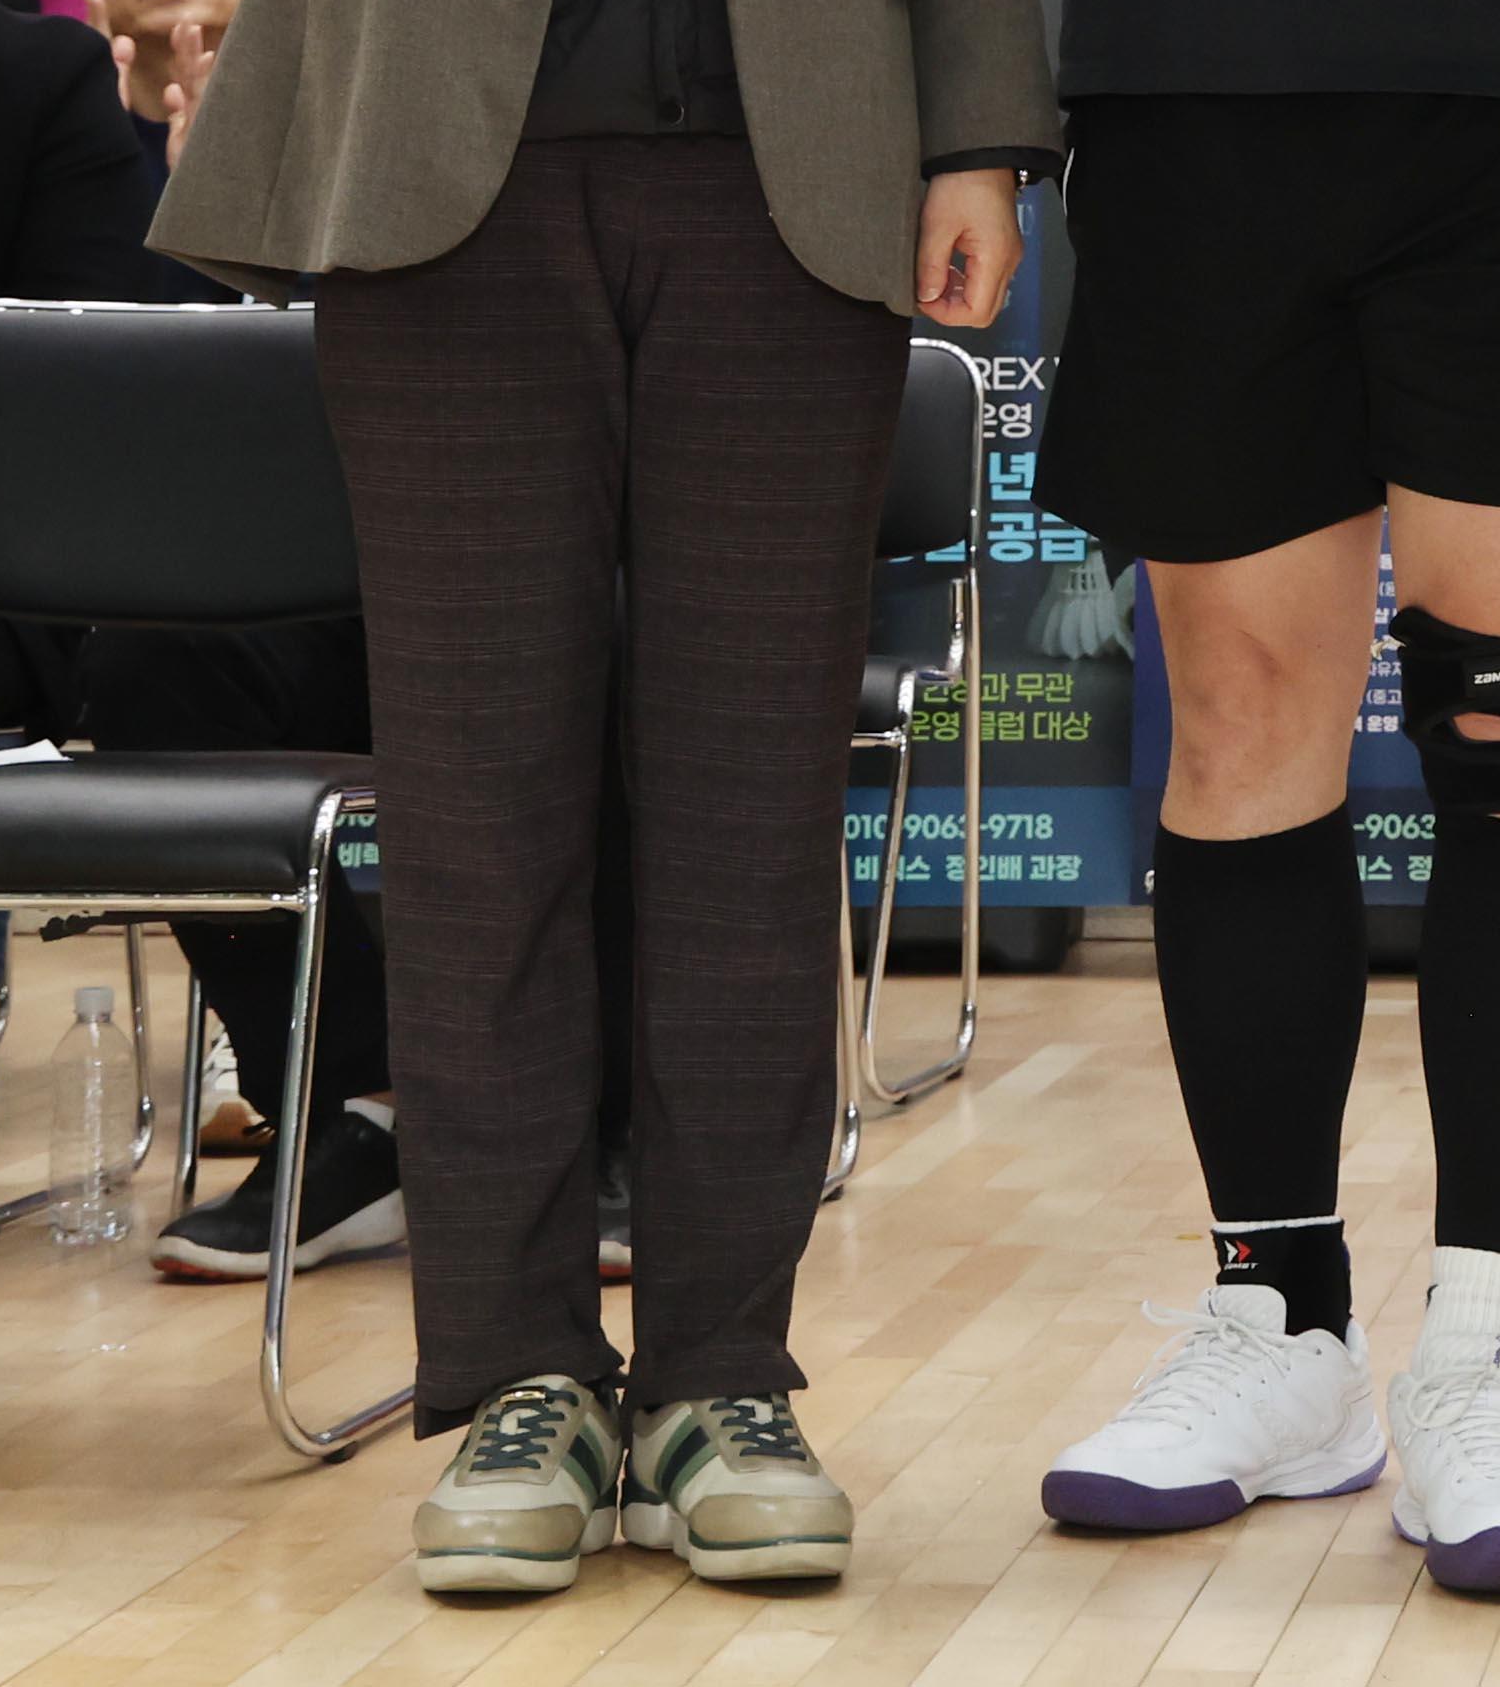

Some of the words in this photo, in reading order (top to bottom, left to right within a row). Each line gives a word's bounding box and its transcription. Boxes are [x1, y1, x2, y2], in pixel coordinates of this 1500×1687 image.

[1015, 672, 1074, 703] 무관
[1032, 711, 1092, 741] 대상
[853, 854, 931, 881] 비스
[1028, 854, 1083, 882] 과장
